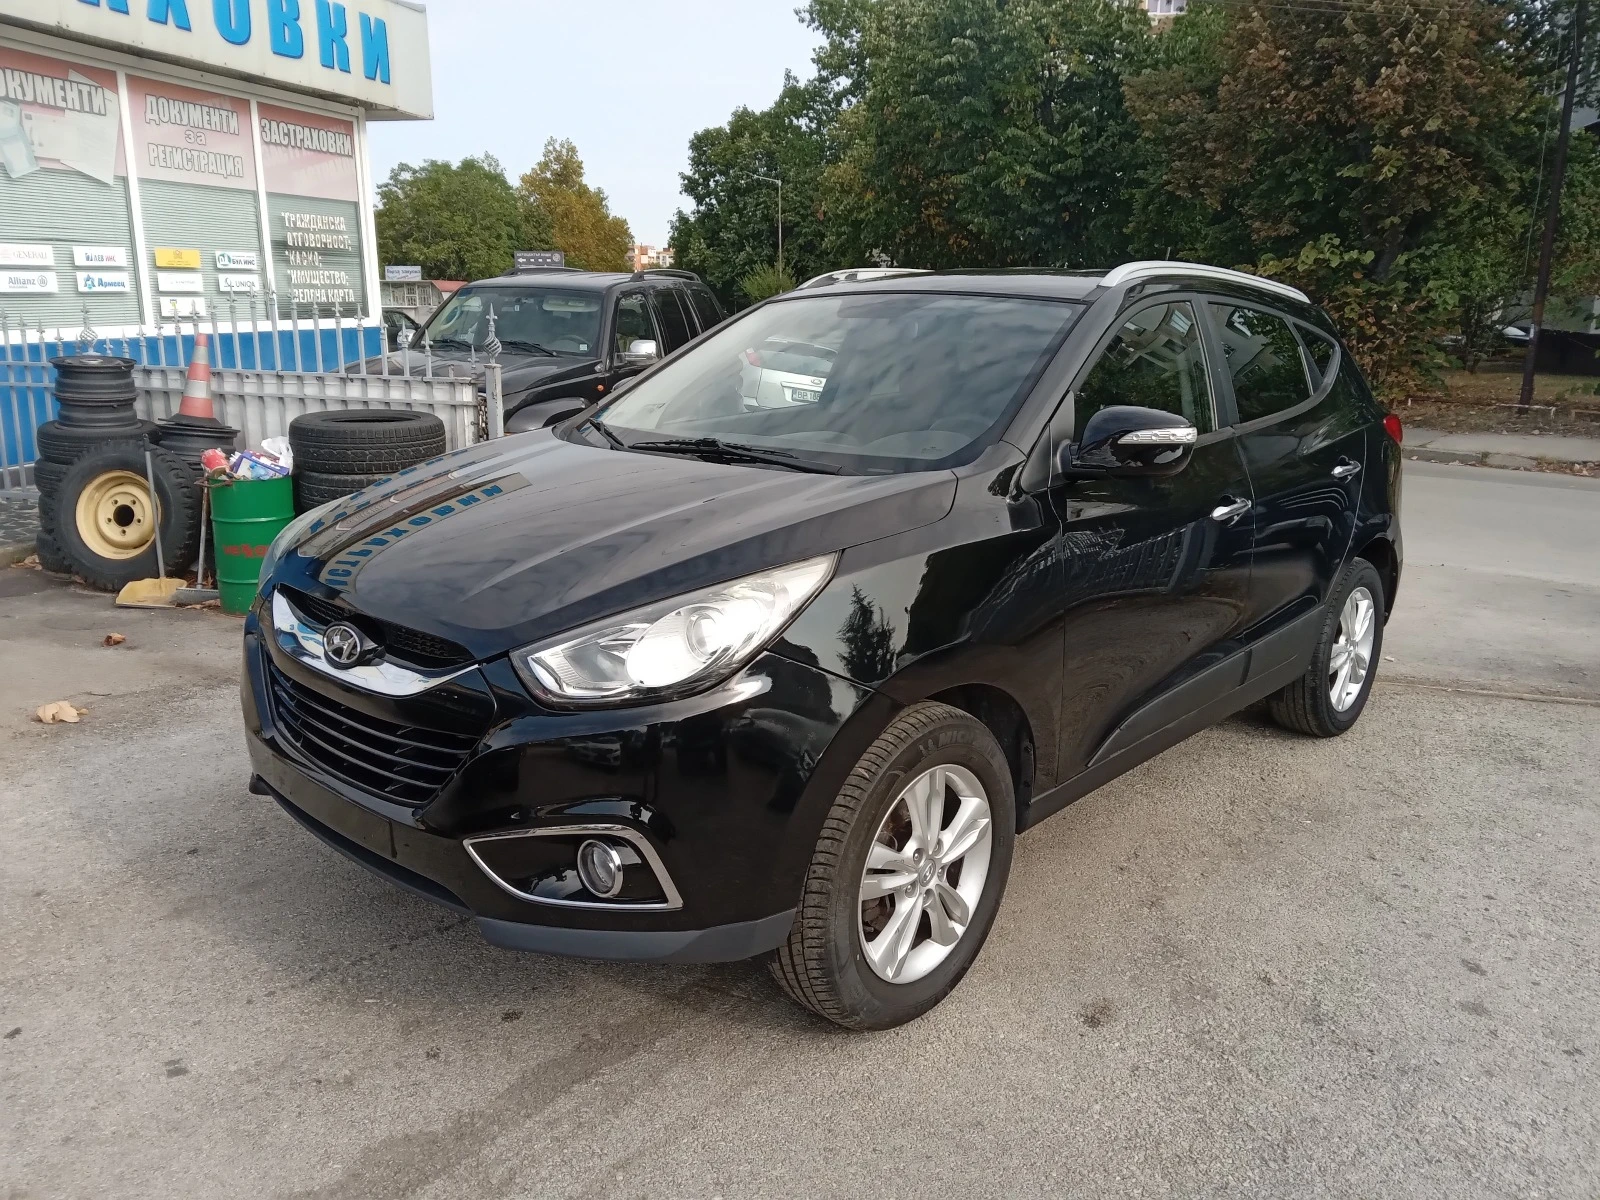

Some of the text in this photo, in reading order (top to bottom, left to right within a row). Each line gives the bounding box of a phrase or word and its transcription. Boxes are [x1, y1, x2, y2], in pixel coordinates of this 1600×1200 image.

[145, 94, 239, 136] ДОКУМЕНТИ
[184, 130, 206, 146] за
[260, 118, 353, 157] ЗАСТРАХОВКИ
[148, 143, 244, 179] РЕГИСТРАЦИЯ
[13, 250, 47, 259] GENERALI
[8, 276, 36, 285] Allianz
[97, 277, 125, 288] Армеец
